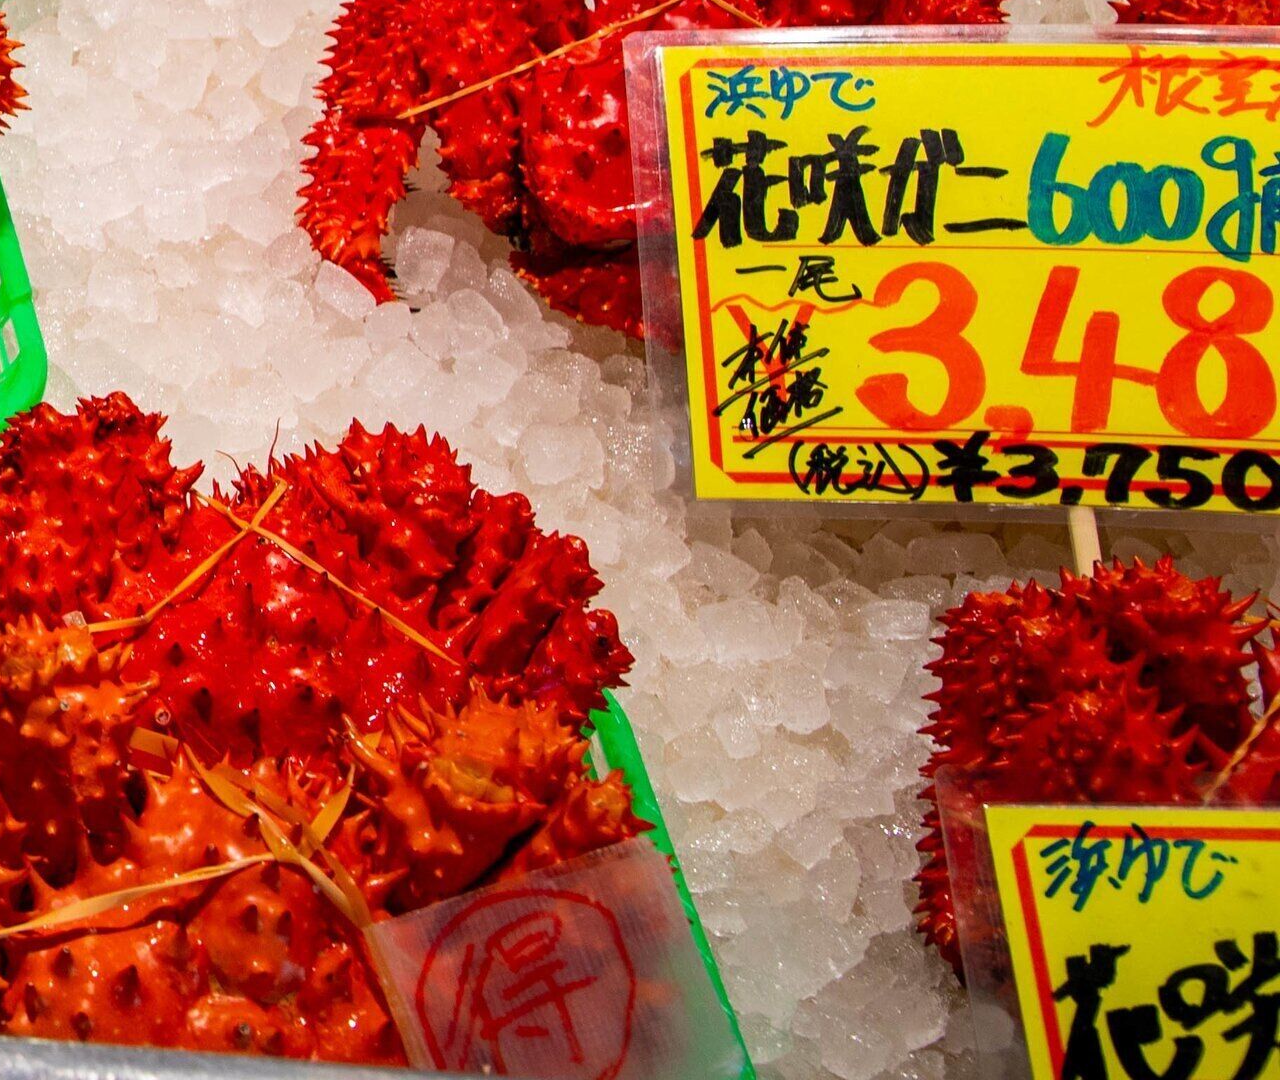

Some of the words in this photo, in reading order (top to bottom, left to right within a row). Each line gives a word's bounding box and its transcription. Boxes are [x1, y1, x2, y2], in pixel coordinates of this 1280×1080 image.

[705, 64, 876, 120] 浜ゆで
[692, 125, 1028, 249] 花咲ガニ
[735, 255, 863, 303] 一尾
[788, 440, 931, 501] (税込)
[931, 430, 1280, 513] ¥3,750
[1040, 821, 1238, 912] 浜ゆで
